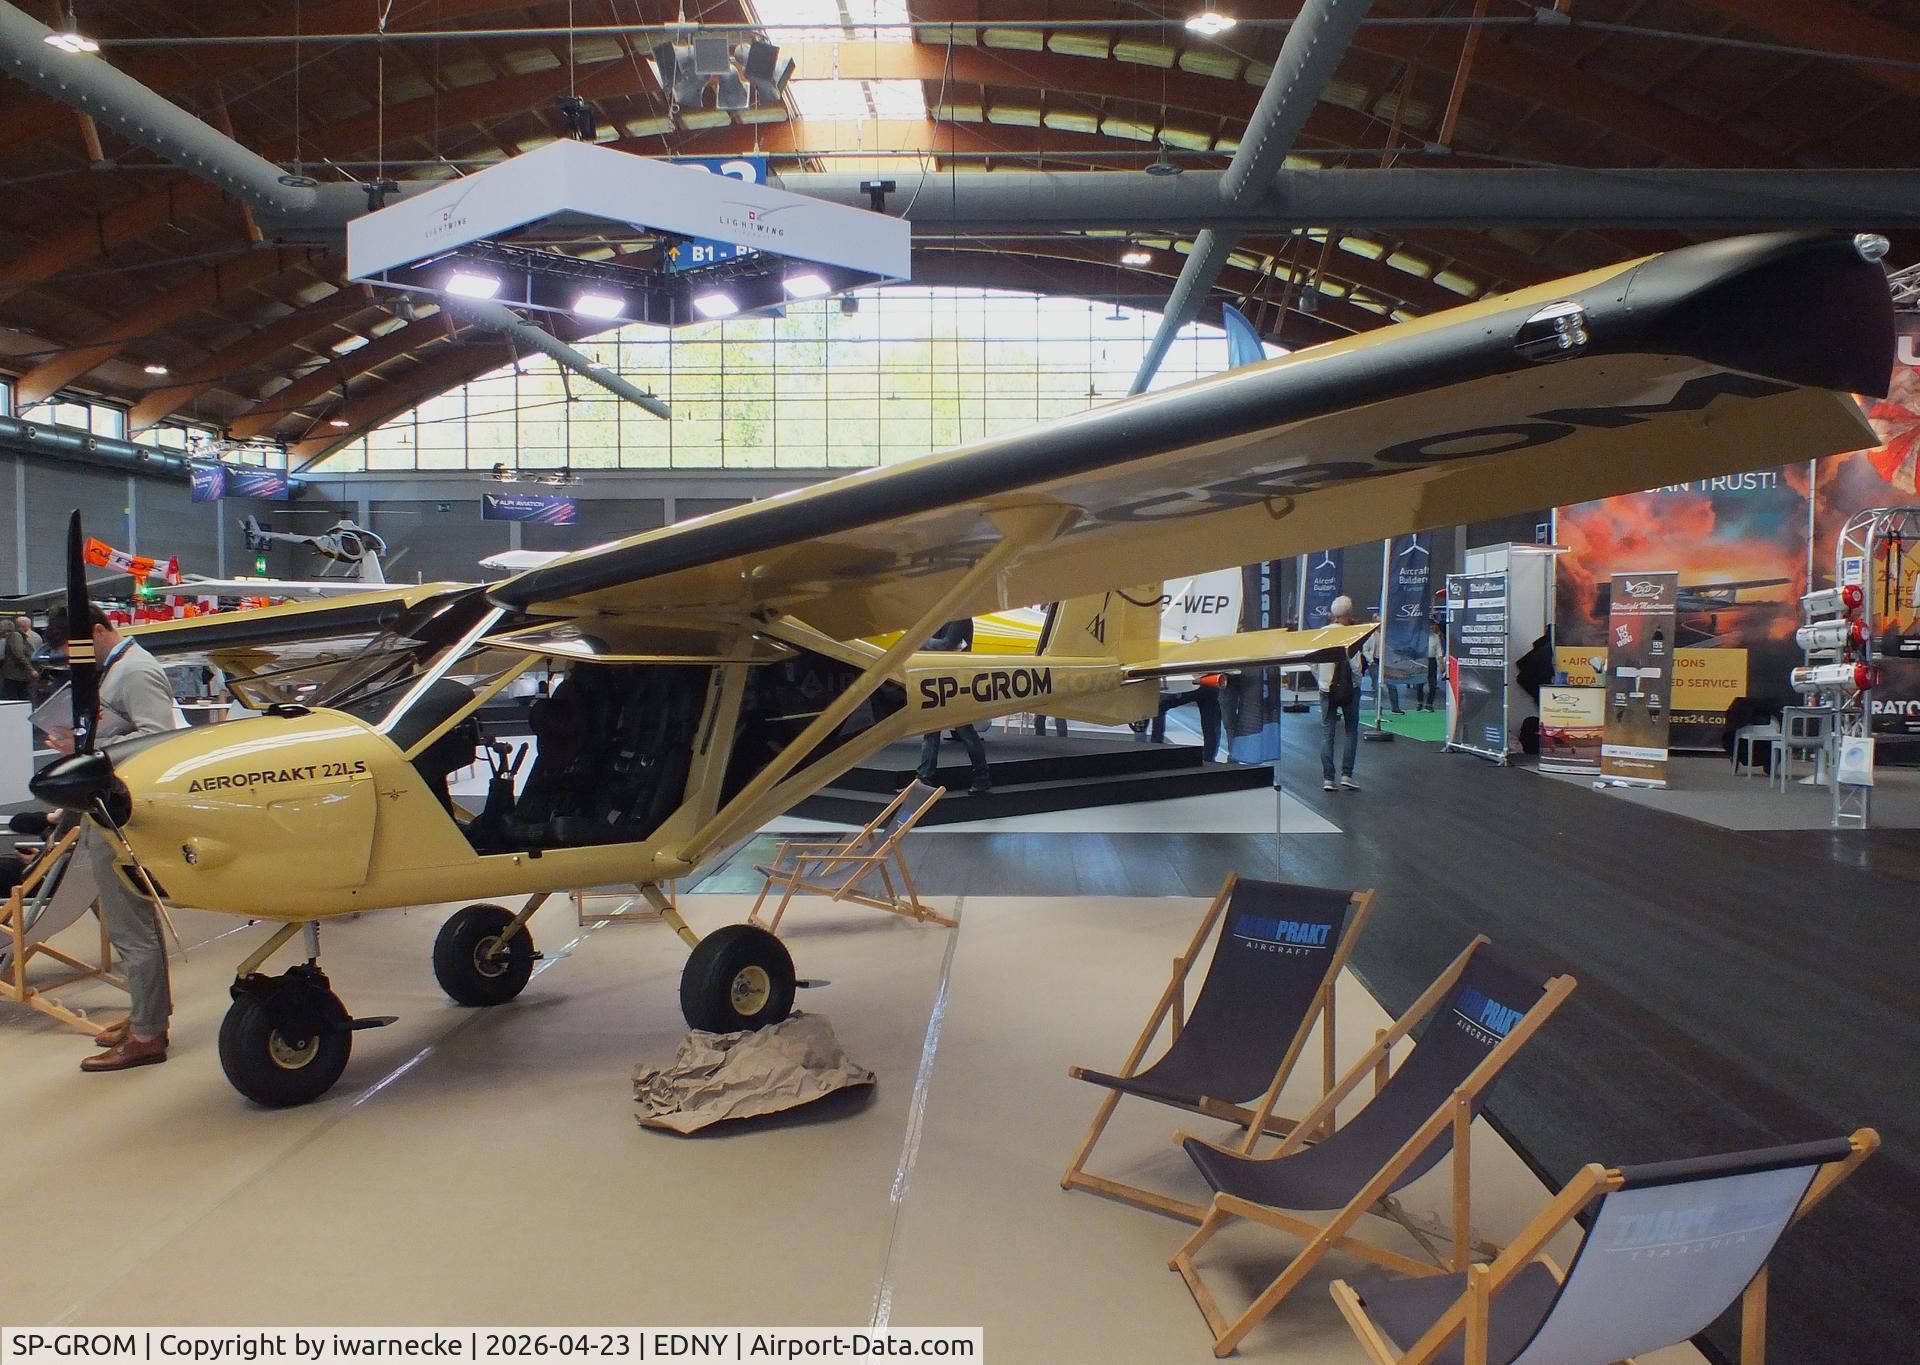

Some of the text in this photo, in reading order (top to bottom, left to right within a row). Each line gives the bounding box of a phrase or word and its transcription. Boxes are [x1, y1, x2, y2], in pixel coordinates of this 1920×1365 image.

[720, 216, 785, 237] LIGHTWING
[692, 246, 714, 262] B1
[1700, 472, 1777, 492] TRUST!
[920, 667, 1052, 709] SP-GROM
[1688, 679, 1738, 688] SERVICE
[188, 761, 367, 793] AEROPRAKT 22LS
[1246, 942, 1311, 956] AIRCRAFT
